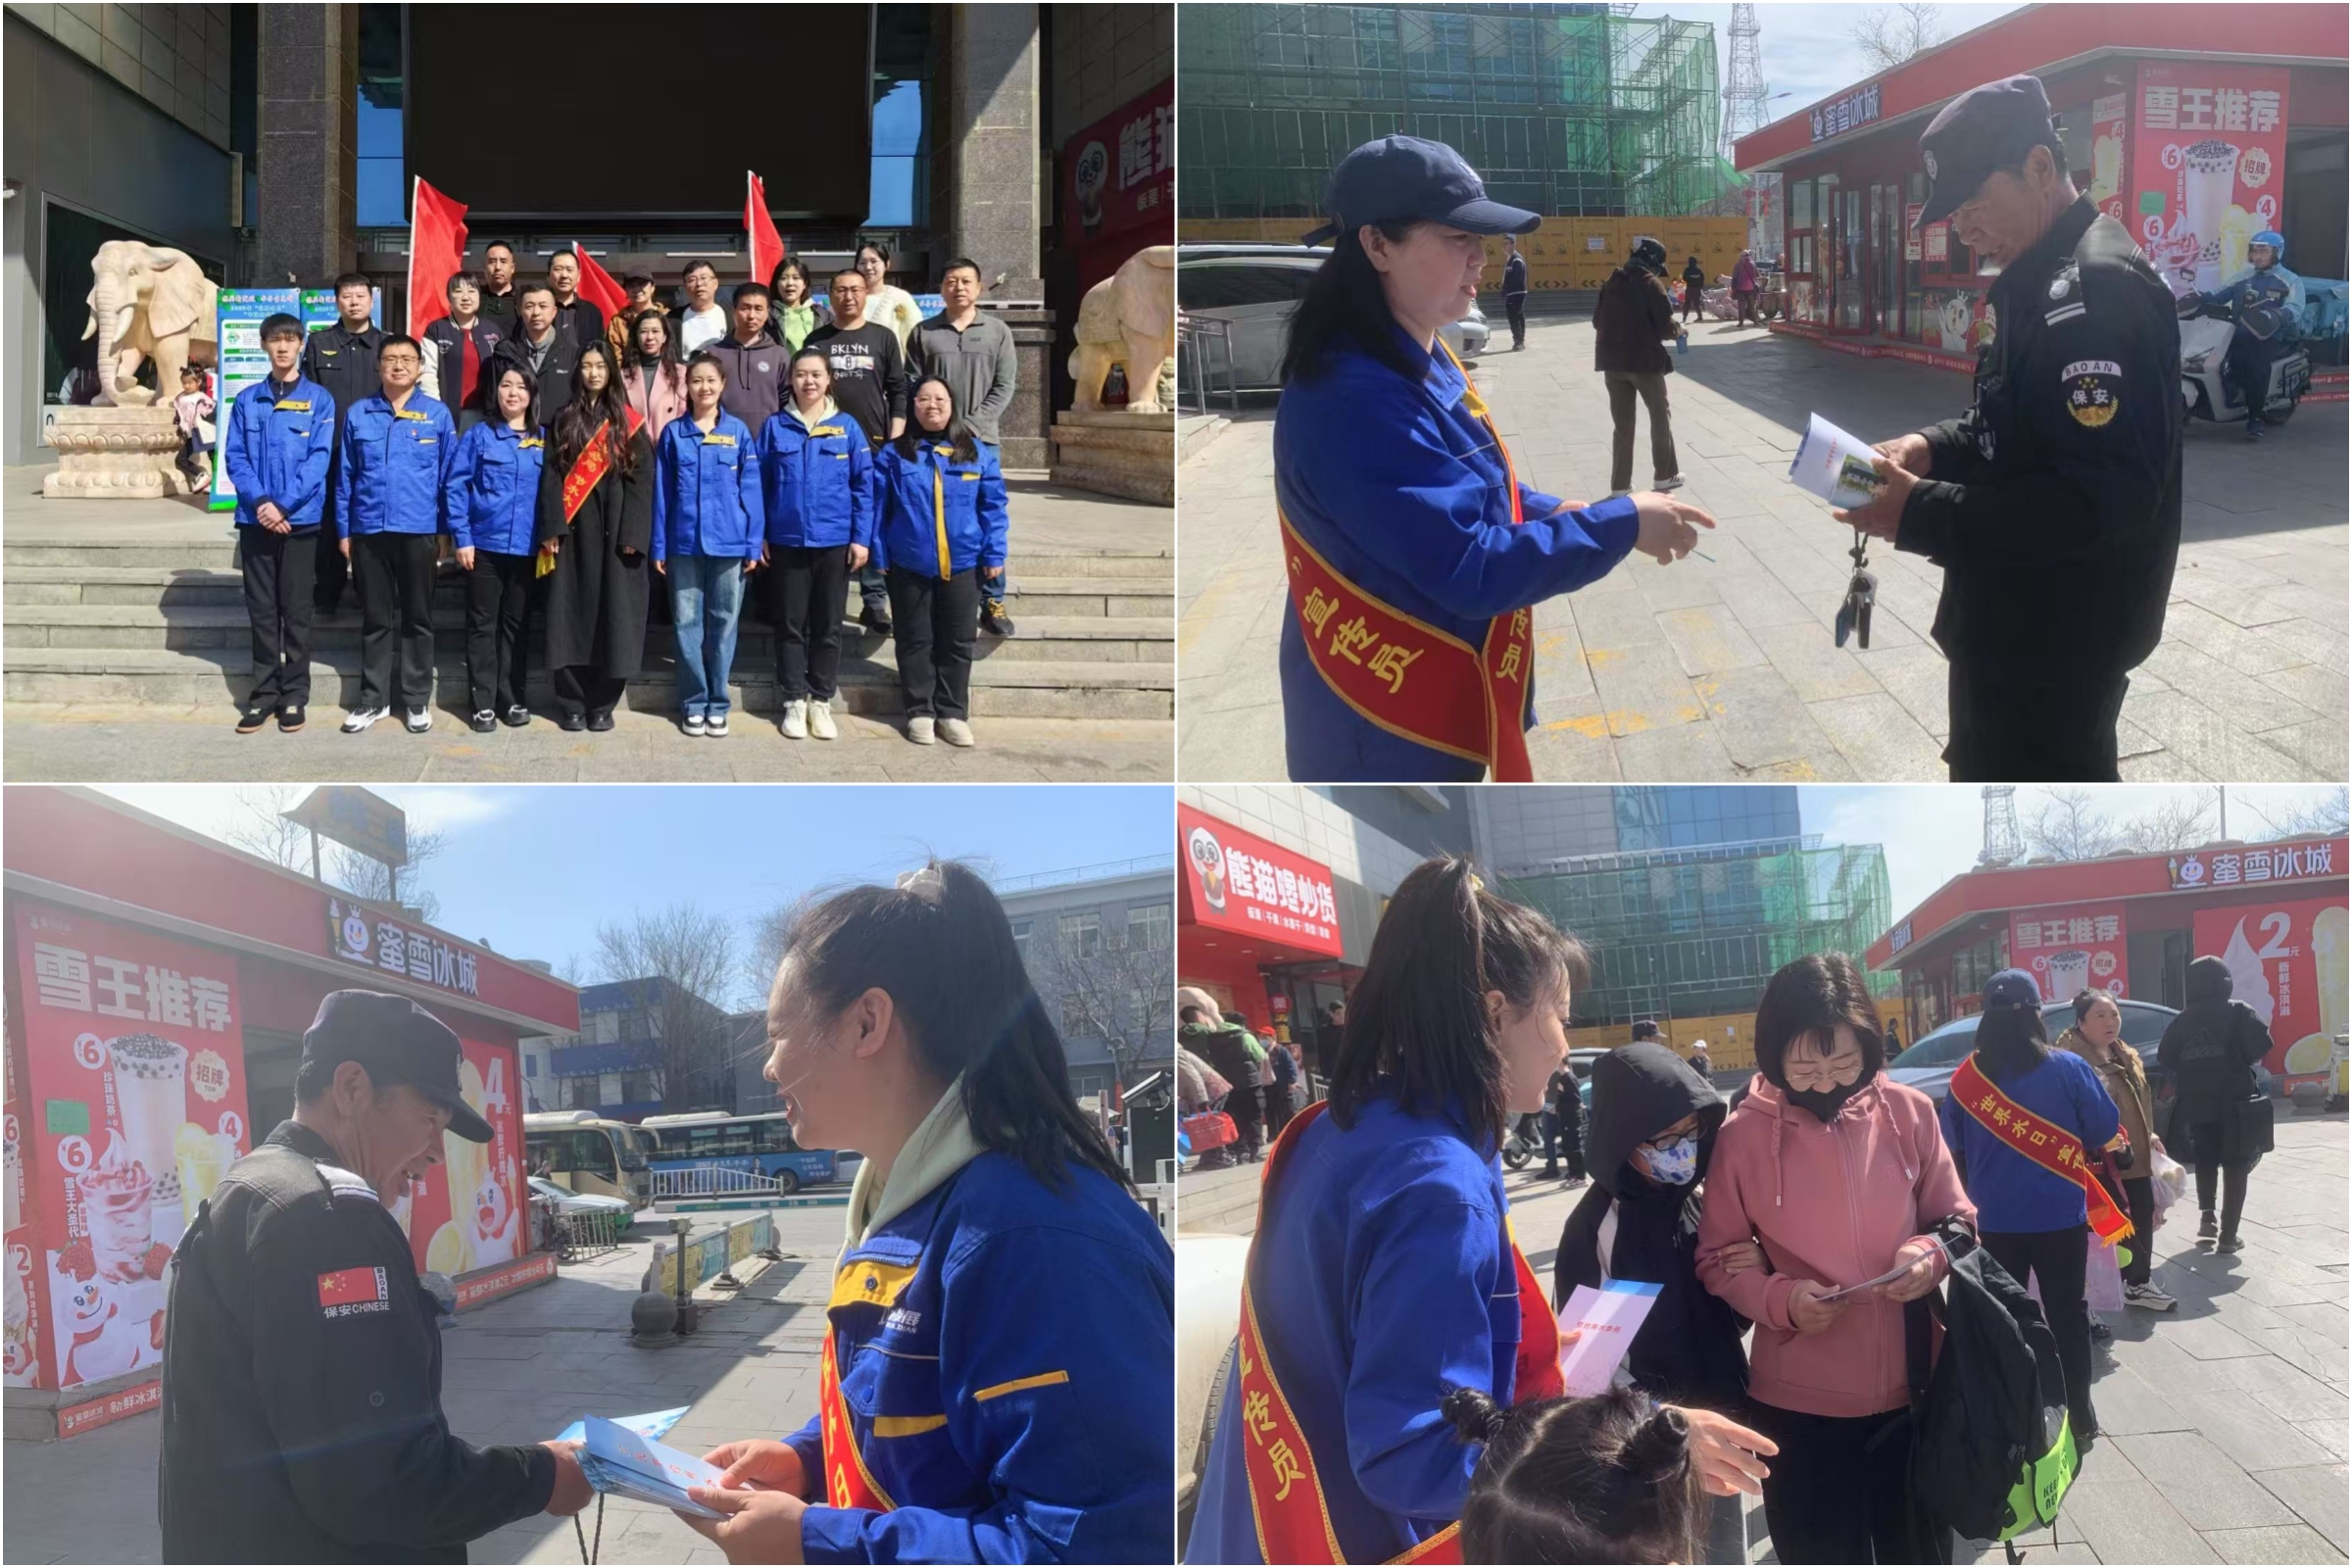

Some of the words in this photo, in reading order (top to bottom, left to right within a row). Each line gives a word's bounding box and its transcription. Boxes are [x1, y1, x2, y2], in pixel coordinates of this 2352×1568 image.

[1824, 83, 1880, 136] 蜜雪冰城
[2144, 85, 2280, 132] 雪王推荐
[2243, 158, 2267, 176] 招牌
[831, 343, 869, 355] BKLYN
[2065, 363, 2089, 376] BAO
[2094, 361, 2114, 371] AN
[2073, 388, 2109, 405] 保安
[2212, 843, 2332, 885] 蜜雪冰城
[2017, 914, 2120, 951] 雪王推荐
[376, 922, 480, 997] 蜜雪冰城
[35, 942, 232, 1032] 雪王推荐
[2278, 960, 2291, 1017] 新鲜冰淇淋
[103, 1071, 117, 1117] 珍珠奶茶
[196, 1061, 224, 1088] 招牌
[64, 1178, 80, 1239] 雪王大圣代
[376, 1267, 387, 1298] BAOAN
